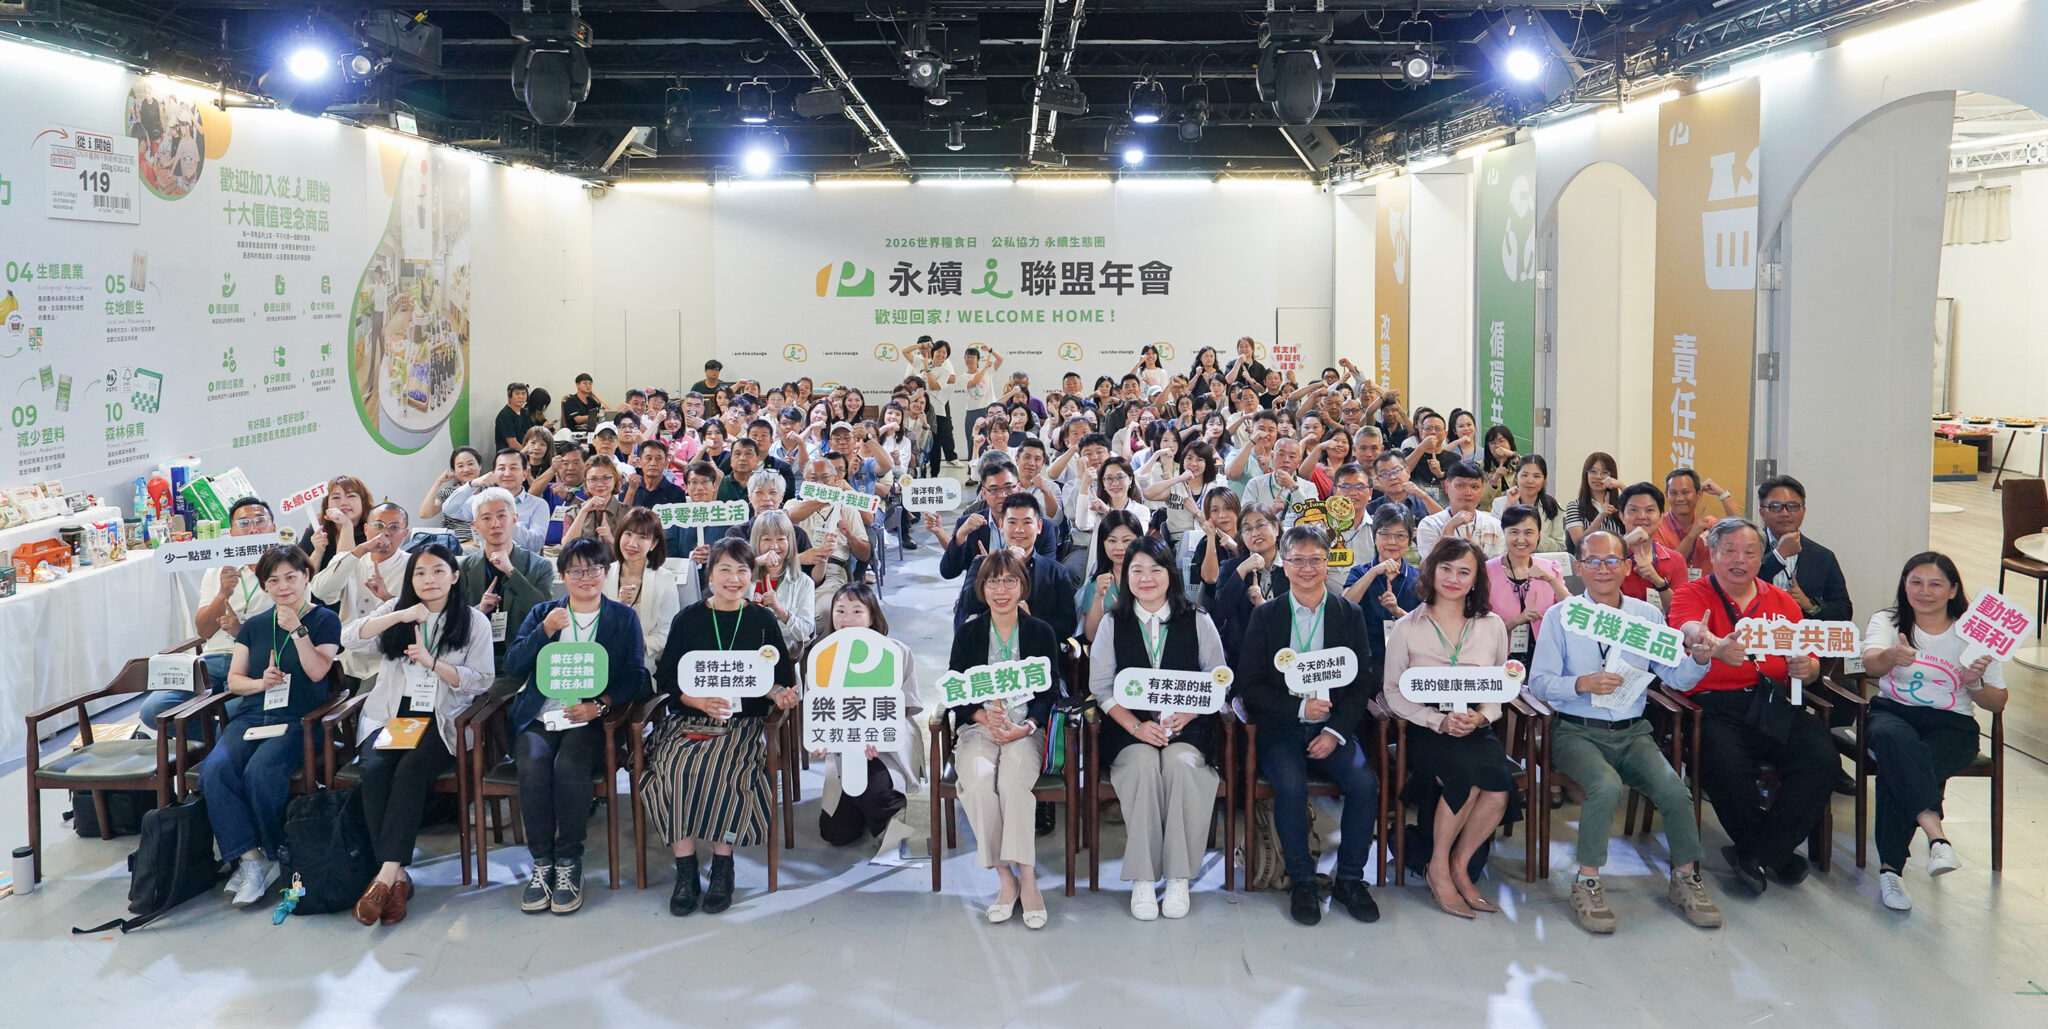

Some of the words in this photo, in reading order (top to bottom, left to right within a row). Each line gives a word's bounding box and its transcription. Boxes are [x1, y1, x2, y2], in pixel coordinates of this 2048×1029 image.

[79, 170, 110, 193] 119
[220, 166, 291, 198] 歡迎加入從
[307, 179, 331, 204] 開始
[223, 199, 330, 233] 十大價值理念商品
[885, 236, 978, 249] 2026世界糧食日
[991, 236, 1041, 248] 公私協力
[6, 261, 34, 283] 04
[36, 263, 84, 280] 生態農業
[888, 260, 963, 297] 永續
[1020, 260, 1173, 297] 聯盟年會
[105, 274, 125, 294] 05
[105, 300, 144, 315] 在地創生
[875, 308, 951, 325] 歡迎回家！
[957, 310, 1045, 323] WELCOME
[12, 404, 38, 427] 09
[105, 402, 123, 422] 10
[17, 426, 65, 448] 減少塑料
[105, 422, 145, 442] 森林保育
[282, 484, 326, 513] 永續GET
[911, 486, 943, 495] 海洋有魚
[911, 496, 943, 505] 餐桌有福
[656, 502, 746, 526] 淨零綠生活
[1975, 593, 2029, 637] 動物
[1566, 602, 1680, 662] 有機產品
[1741, 623, 1855, 653] 社會共融
[1961, 614, 2016, 657] 福利
[694, 659, 754, 673] 善待土地，
[1296, 655, 1346, 672] 今天的永續
[1924, 654, 1938, 662] am
[694, 674, 758, 688] 好菜自然來
[942, 662, 1047, 702] 食農教育
[1148, 677, 1213, 694] 有來源的紙
[1301, 670, 1342, 685] 從我開始
[1410, 677, 1504, 692] 我的健康無添加
[811, 695, 897, 722] 樂家康
[1147, 691, 1211, 708] 有未來的樹
[811, 727, 897, 743] 文教基金會
